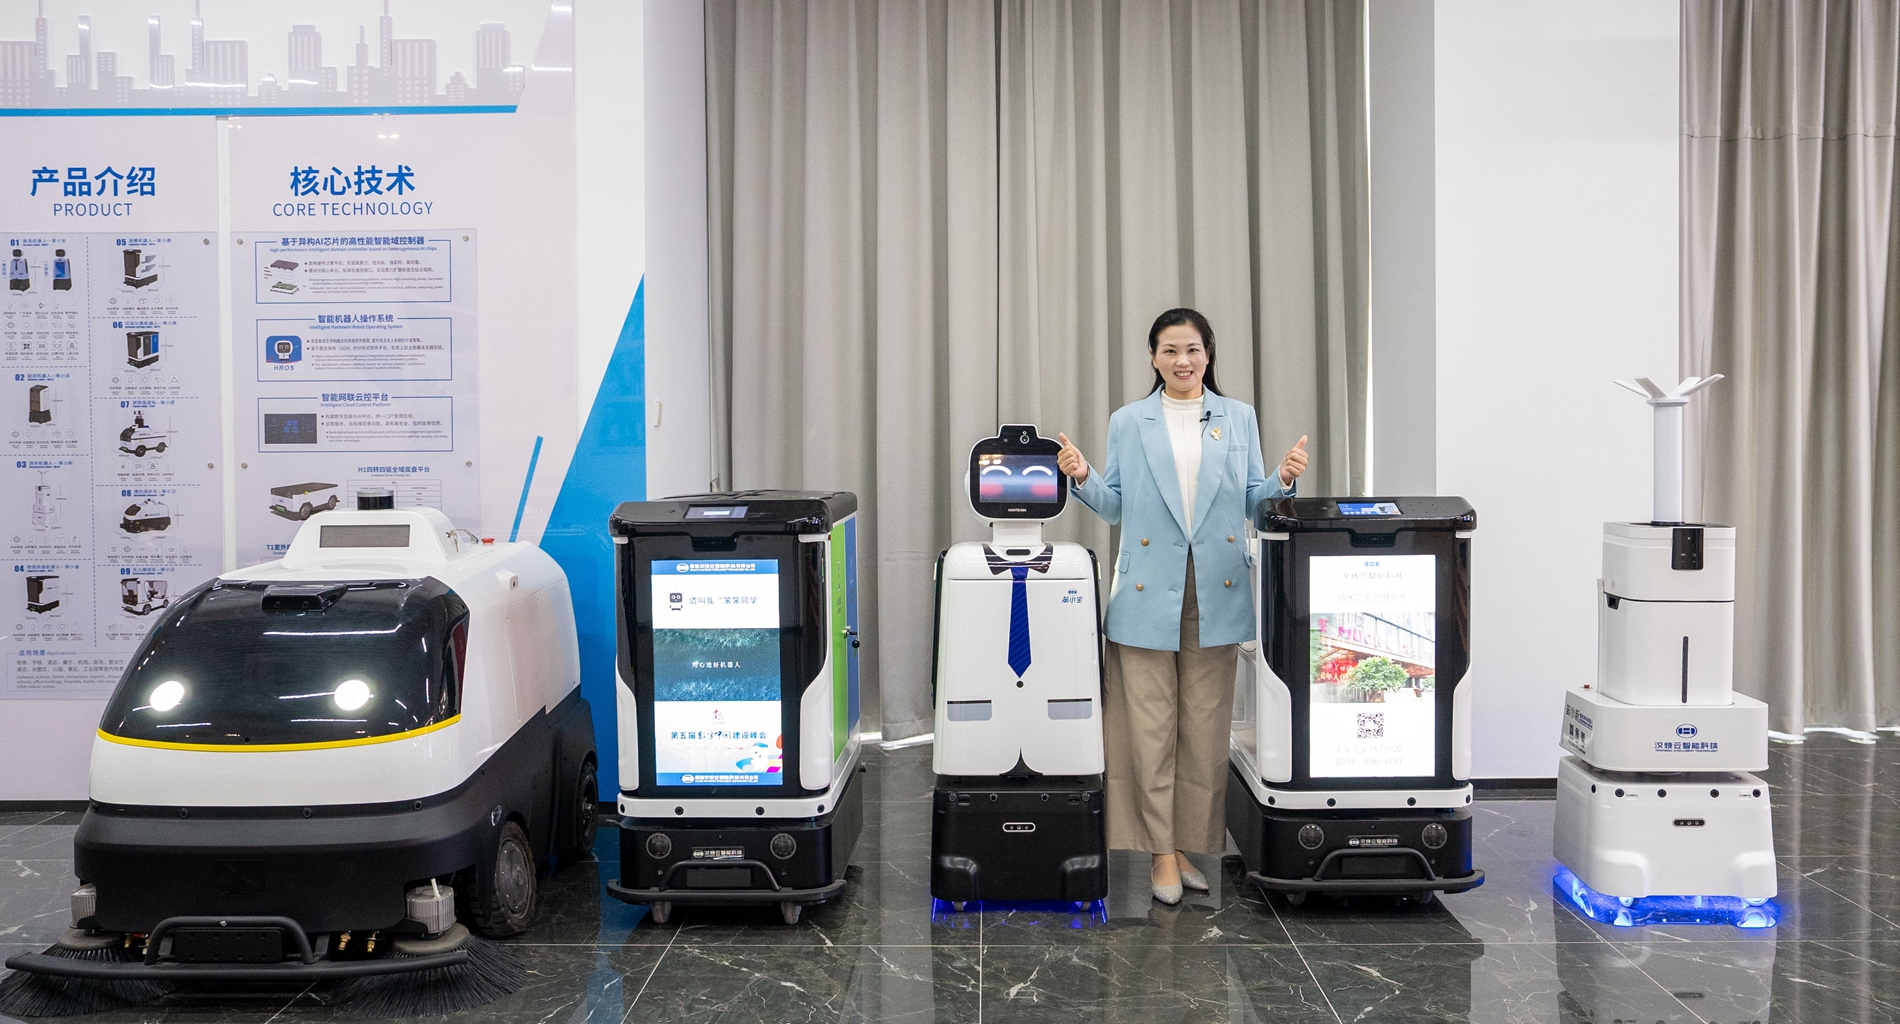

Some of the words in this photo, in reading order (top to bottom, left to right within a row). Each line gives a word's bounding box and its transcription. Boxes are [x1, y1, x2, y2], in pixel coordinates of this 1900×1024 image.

[30, 166, 156, 196] 产品介绍
[290, 165, 415, 196] 核心技术
[54, 203, 133, 216] PRODUCT
[273, 203, 316, 216] CORE
[321, 202, 433, 216] TECHNOLOGY
[282, 236, 424, 247] 基于异构AI芯片的高性能智能域控制器
[318, 314, 394, 323] 智能机器人操作系统
[322, 393, 388, 402] 智能网联云控平台
